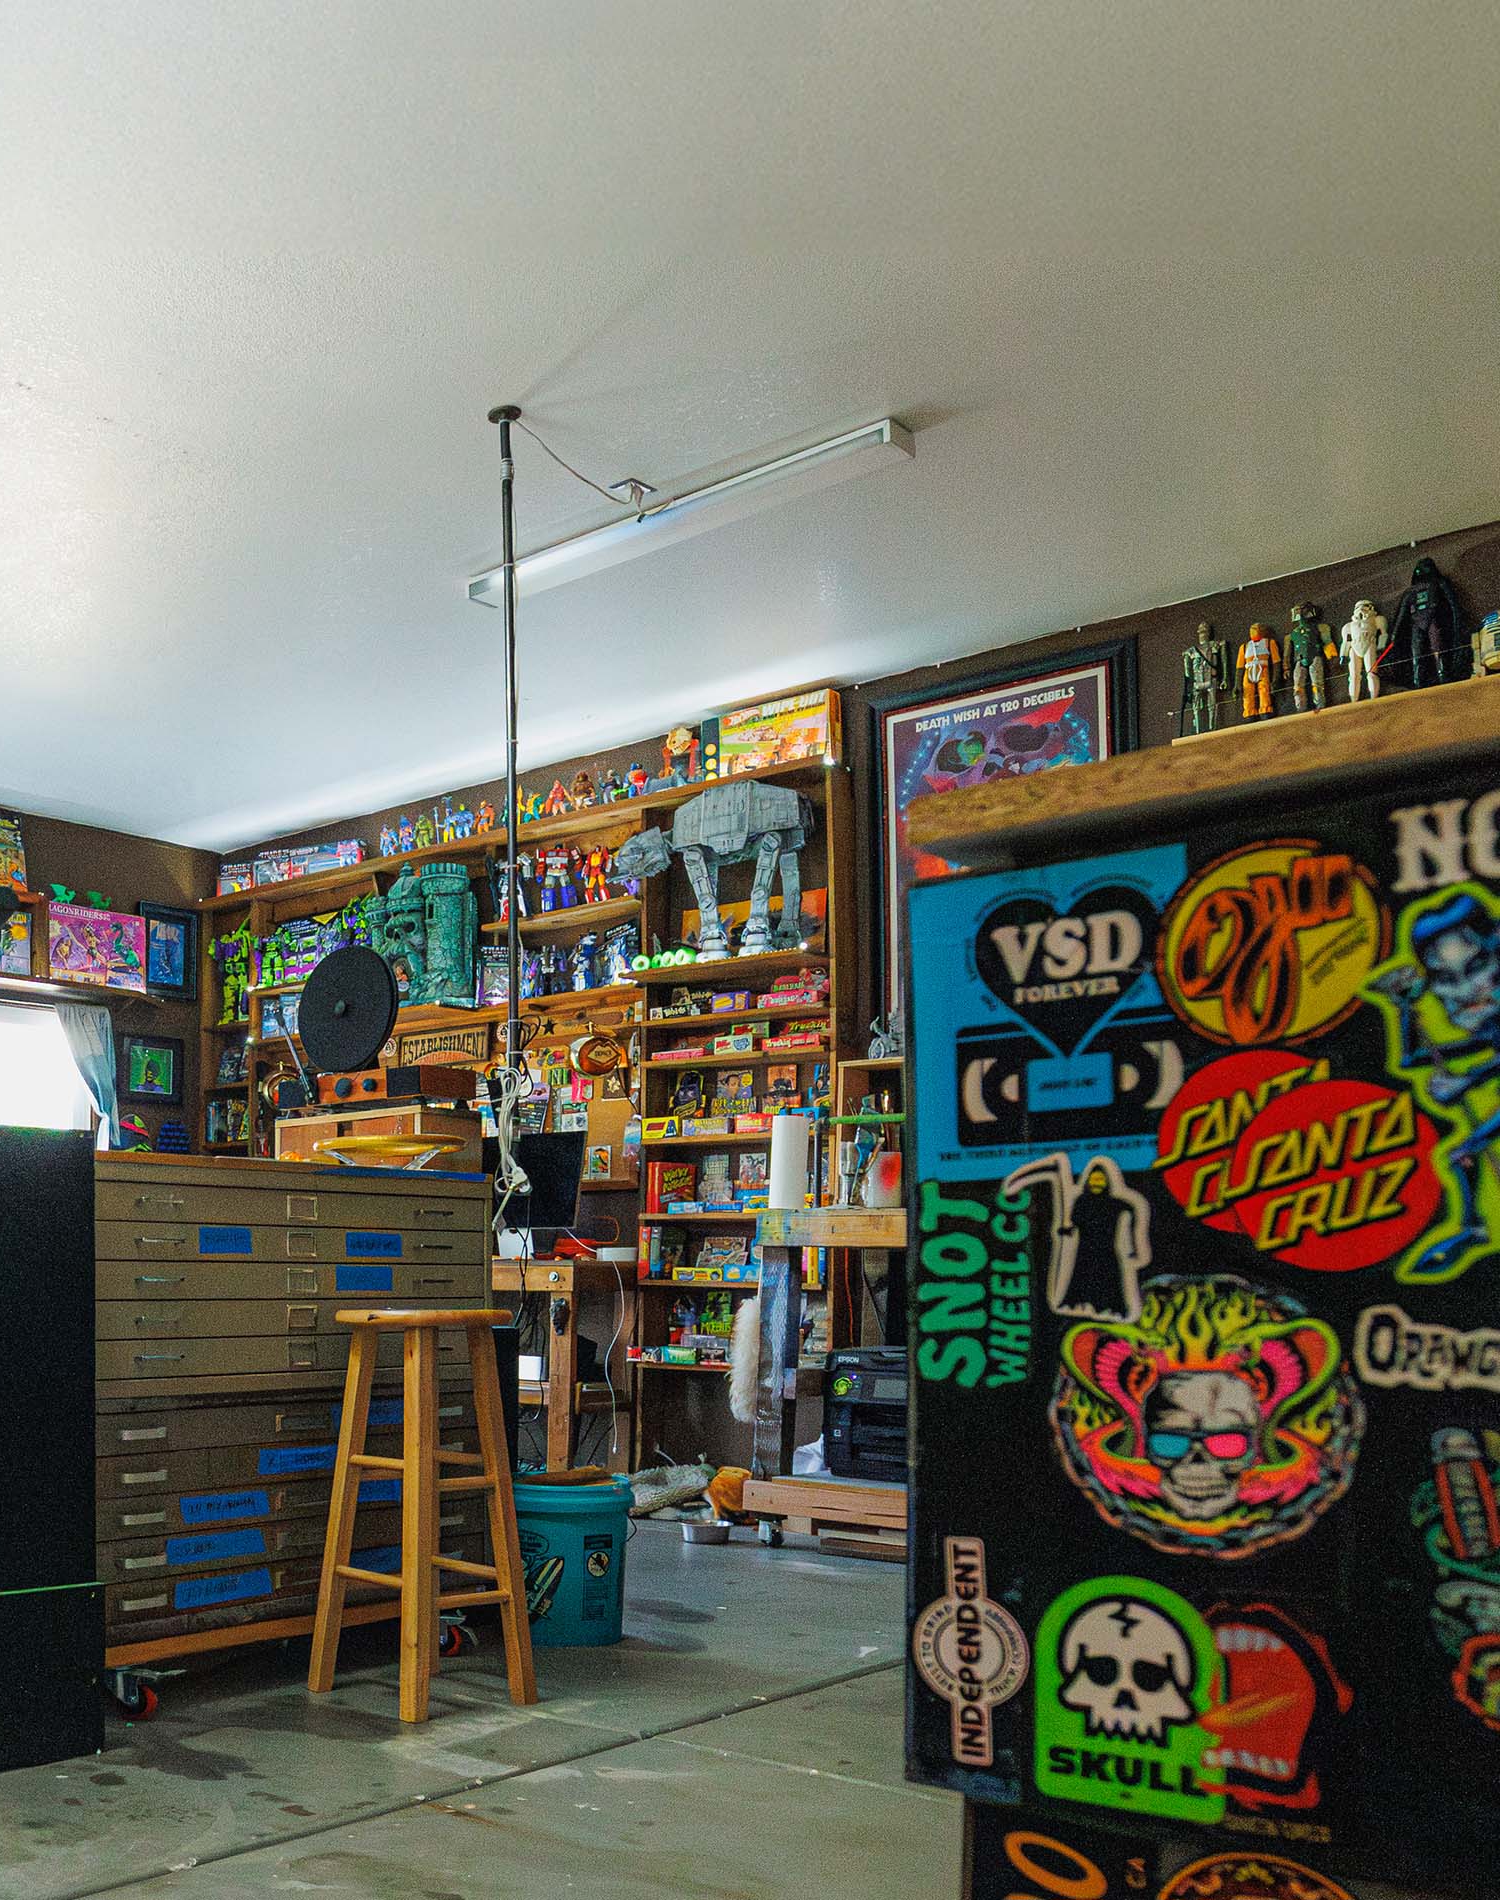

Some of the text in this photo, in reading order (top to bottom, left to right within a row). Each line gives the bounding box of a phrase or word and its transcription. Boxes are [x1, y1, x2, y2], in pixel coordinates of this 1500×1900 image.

[915, 686, 1075, 733] DEATH WISH AT 120 DECIBELS
[49, 903, 104, 919] AGONRIDERS
[989, 909, 1143, 986] VSD
[1012, 975, 1121, 1005] FOREVER
[402, 1031, 486, 1066] ESTABLISHMENT
[1219, 1091, 1416, 1198] SANTA
[1255, 1157, 1417, 1251] CRUZ
[918, 1180, 990, 1389] SNOT
[987, 1252, 1031, 1389] WHEEL
[954, 1544, 987, 1758] INDEPENDENT
[1048, 1745, 1211, 1797] SKULL
